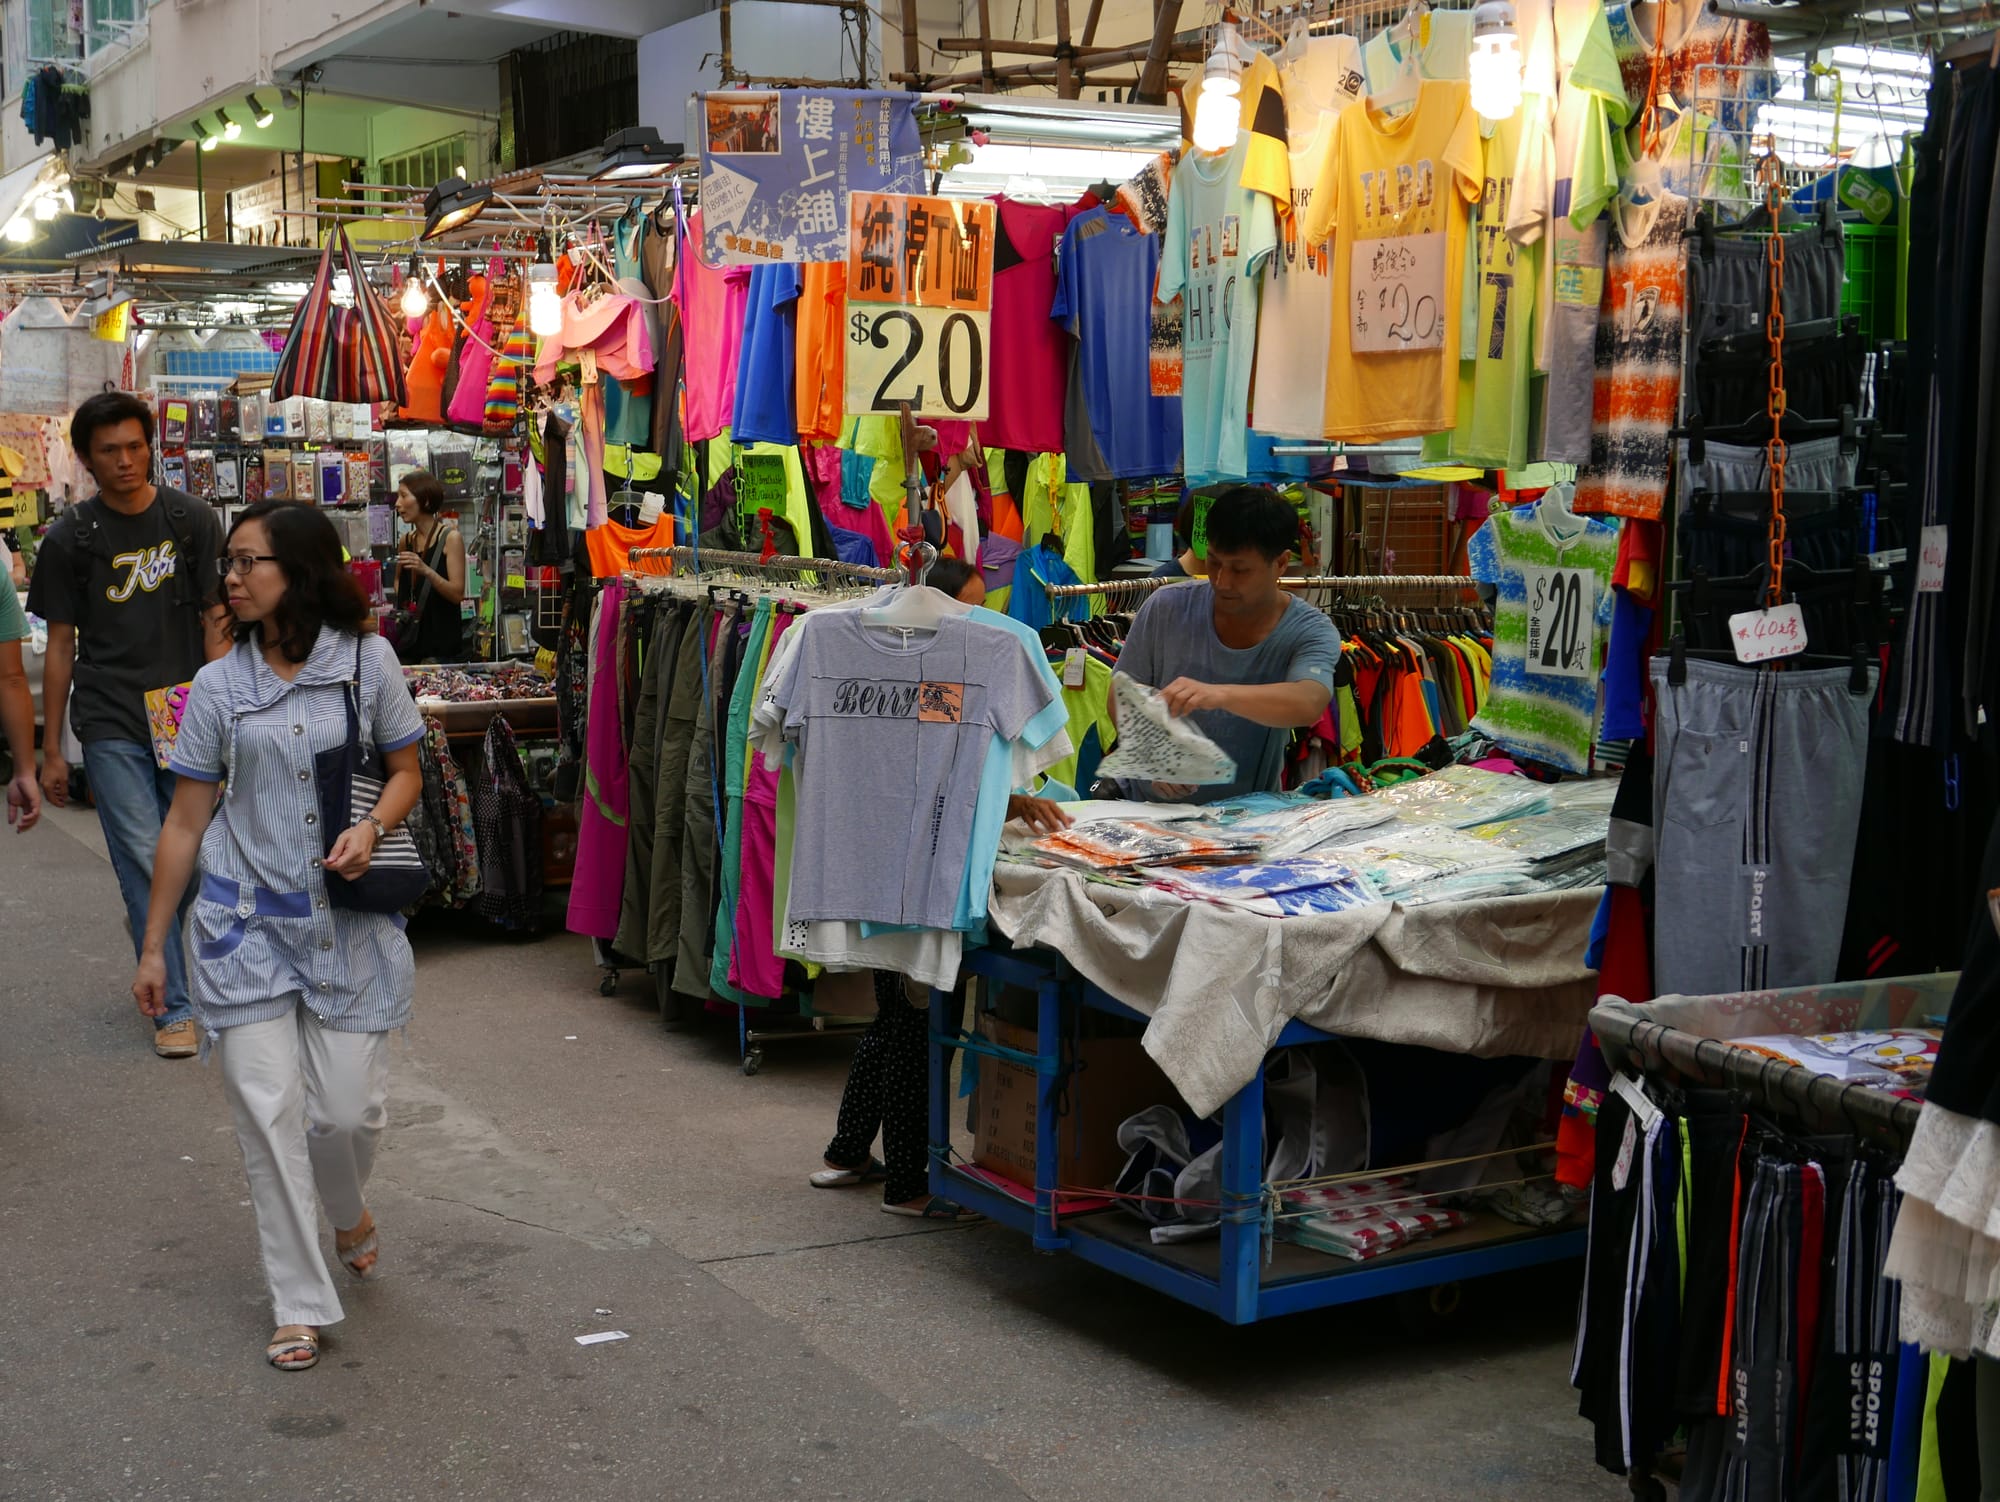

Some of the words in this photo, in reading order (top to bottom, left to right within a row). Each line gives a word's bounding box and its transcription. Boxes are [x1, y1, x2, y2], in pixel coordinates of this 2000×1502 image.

[860, 199, 981, 302] 純棉T恤
[850, 309, 983, 414] $20
[1533, 571, 1581, 670] $20
[833, 681, 918, 717] Berry
[1750, 869, 1767, 937] SPORT
[1735, 1367, 1749, 1447] SPORT
[1864, 1359, 1883, 1447] SPORT
